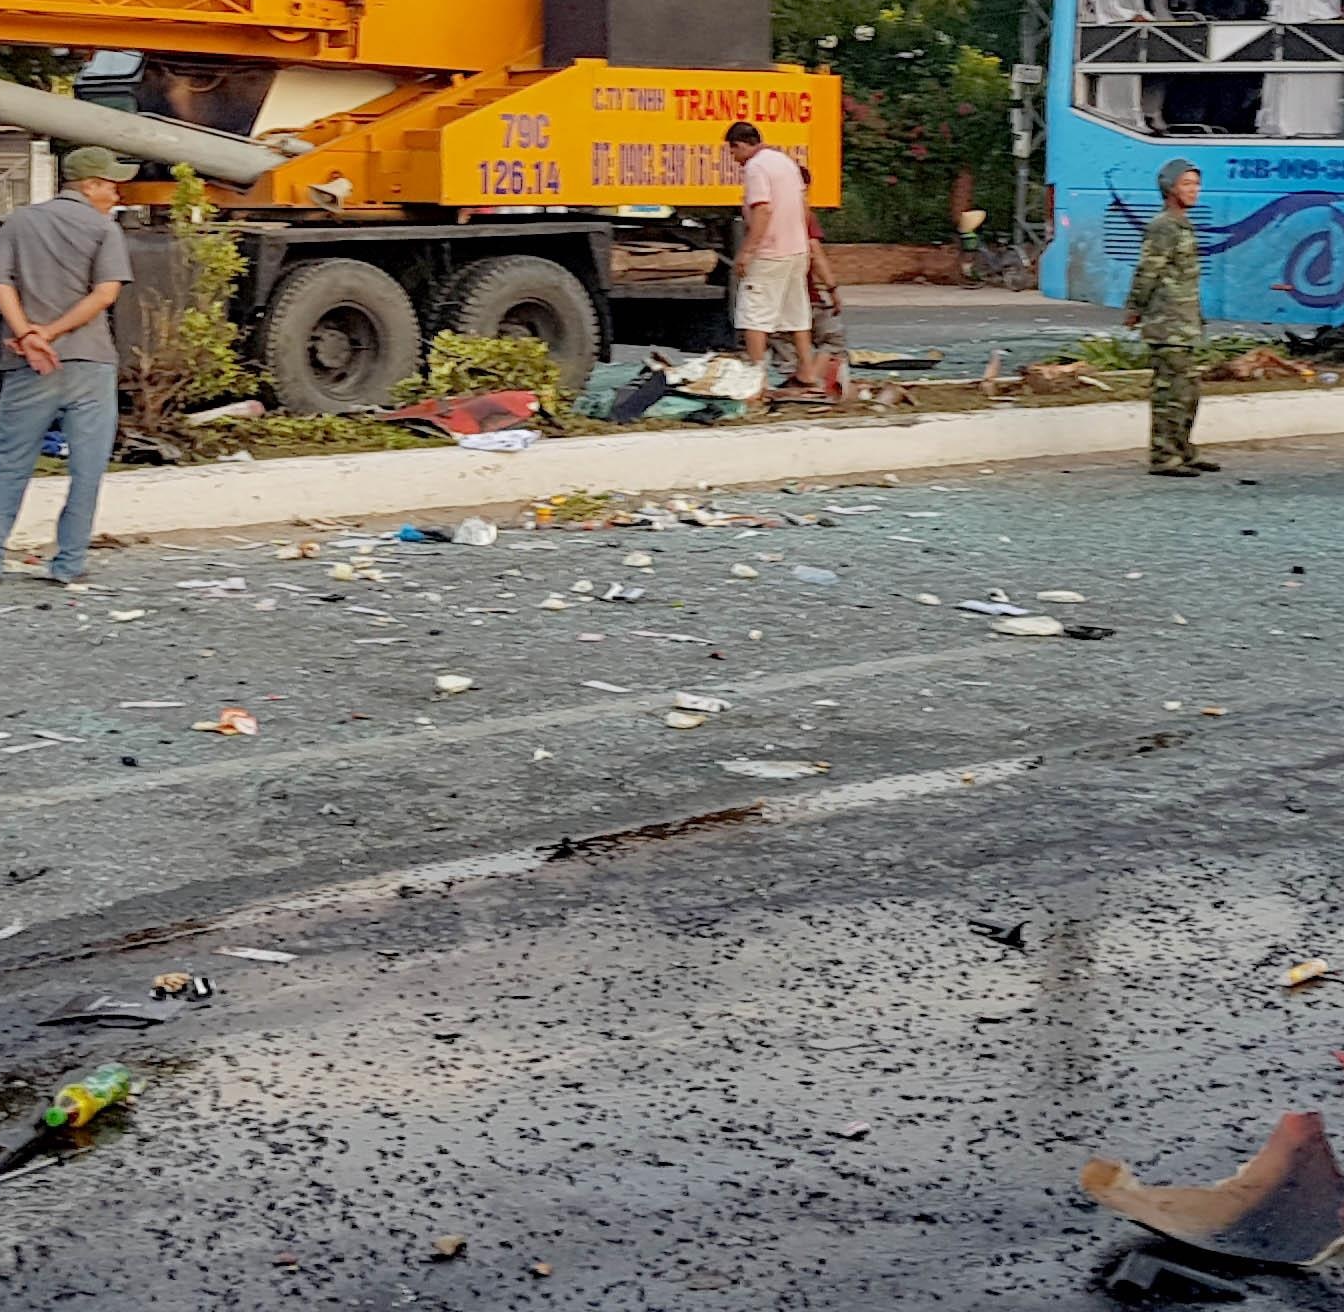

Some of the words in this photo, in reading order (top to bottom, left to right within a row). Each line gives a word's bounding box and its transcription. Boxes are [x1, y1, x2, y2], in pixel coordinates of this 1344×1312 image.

[672, 89, 750, 121] TRANG
[754, 91, 812, 123] LONG
[498, 113, 551, 149] 79C
[479, 160, 561, 195] 126.14
